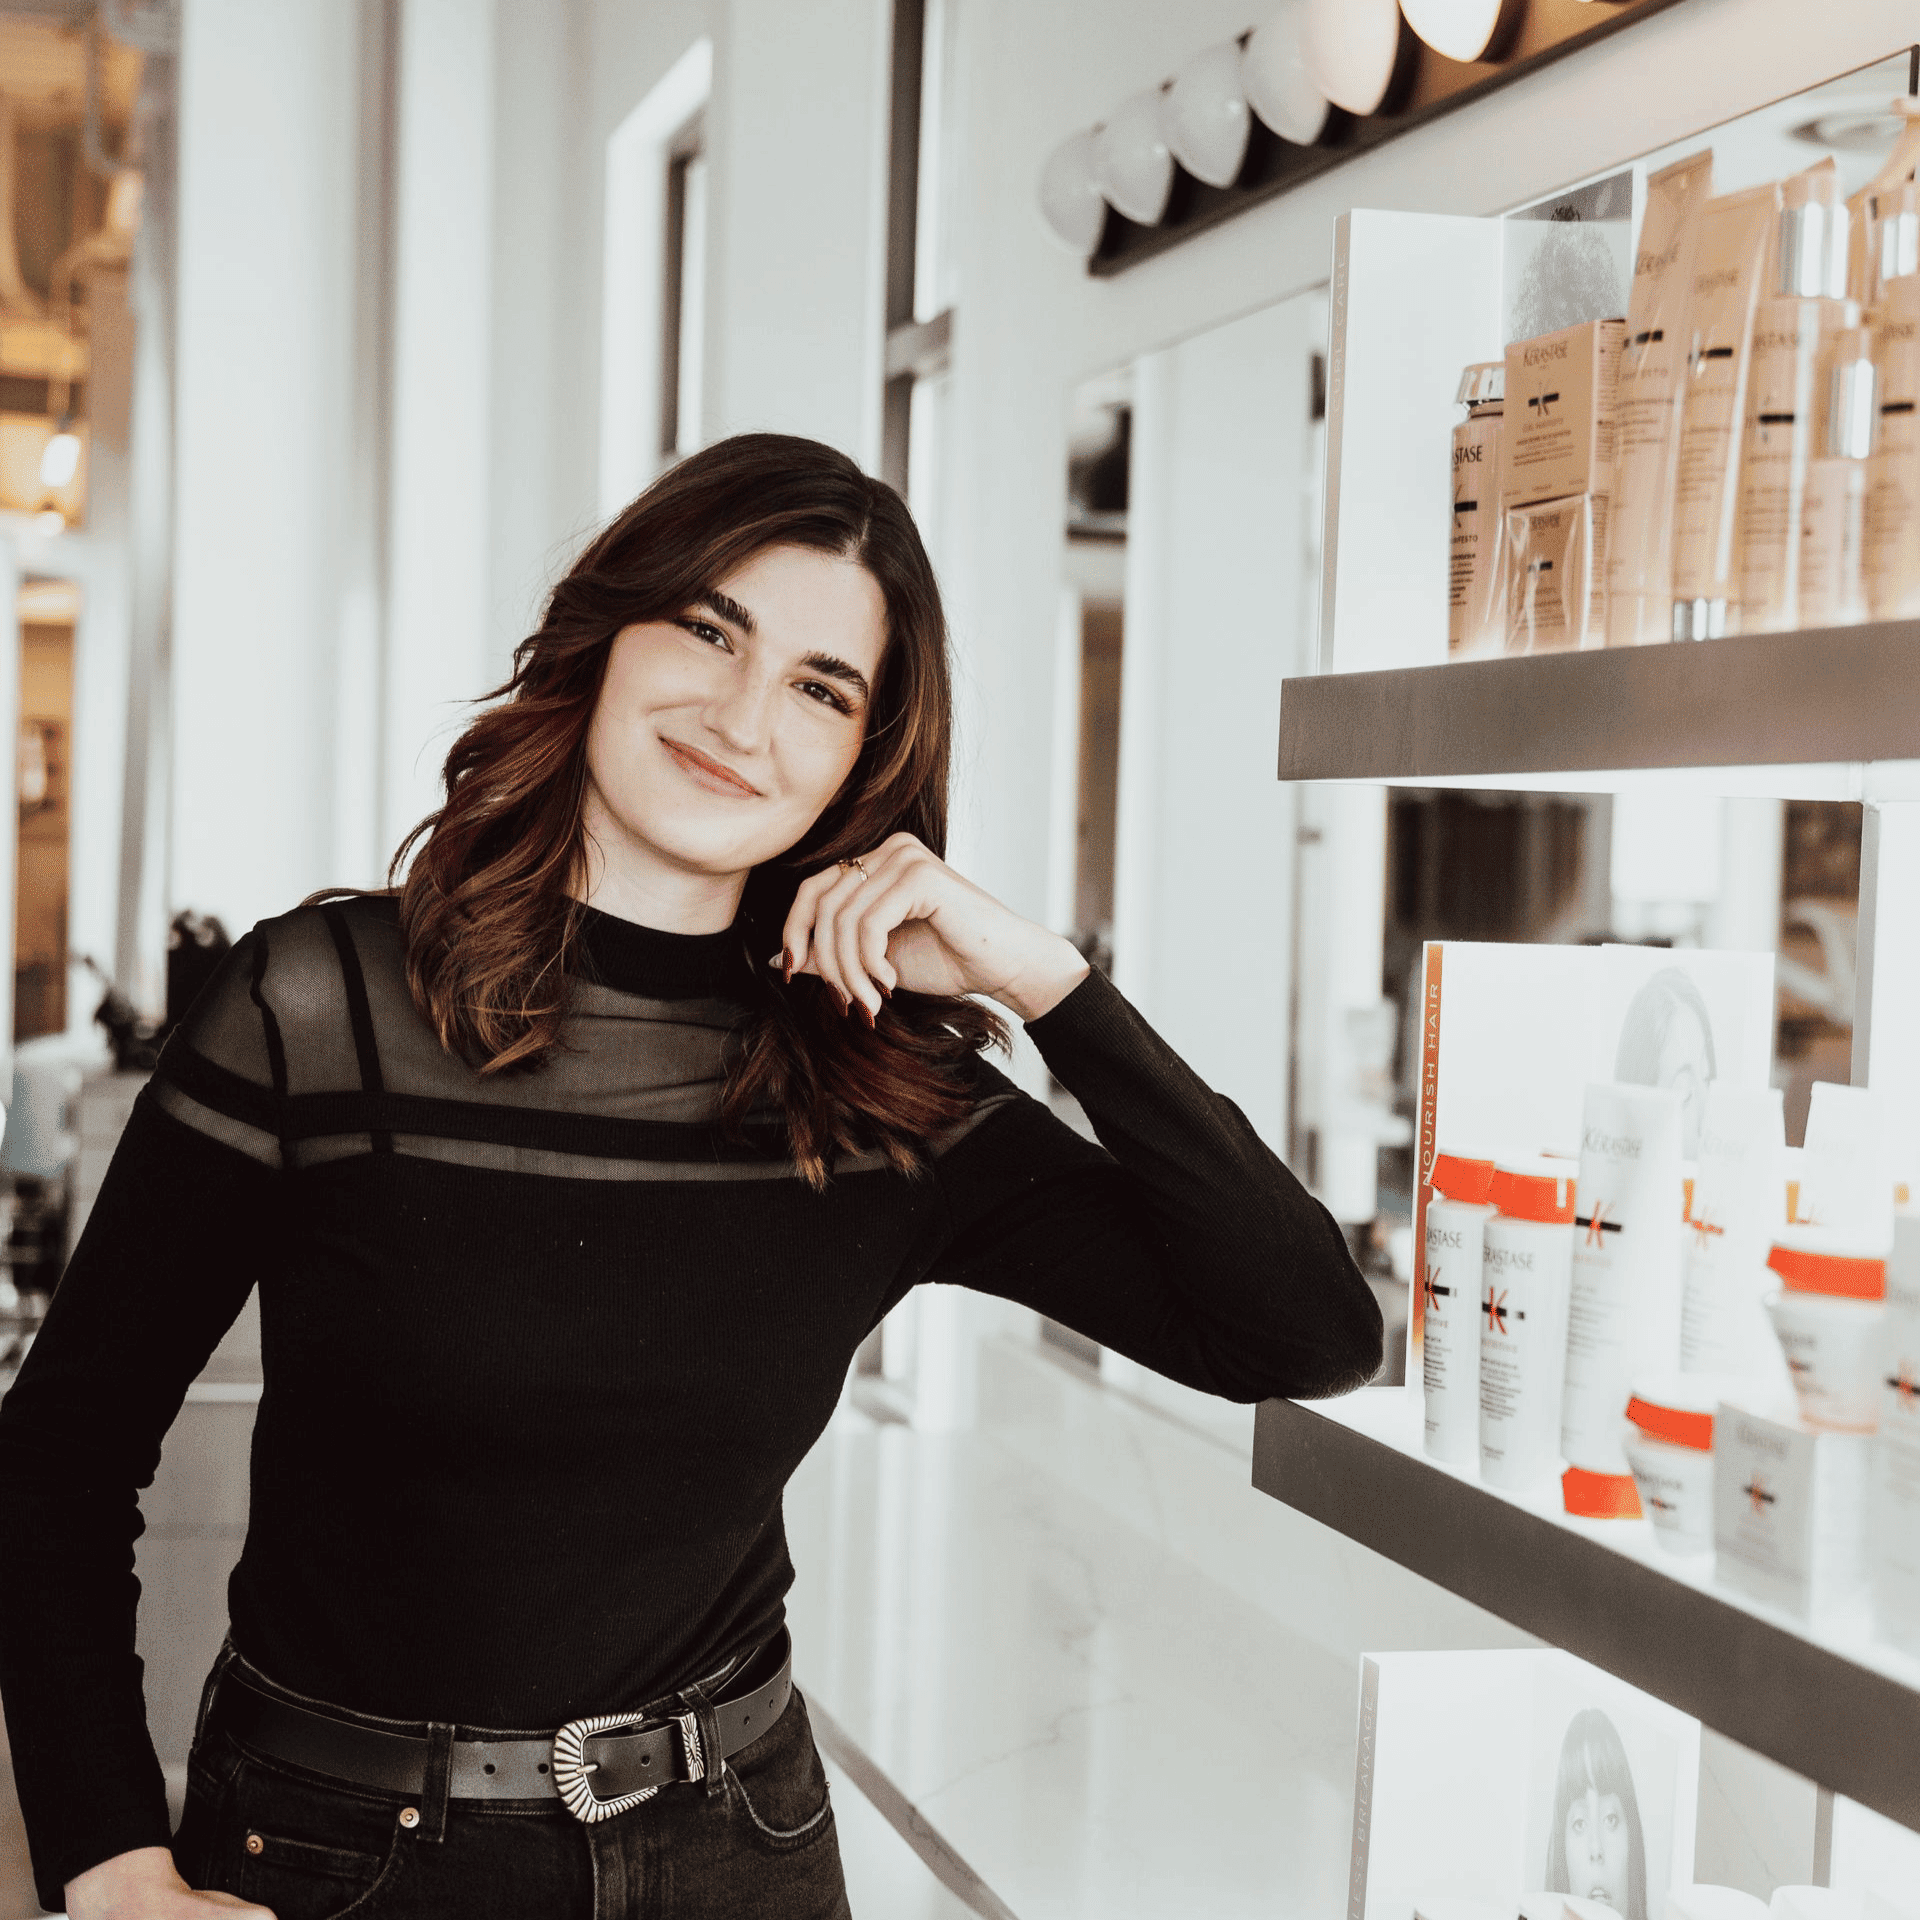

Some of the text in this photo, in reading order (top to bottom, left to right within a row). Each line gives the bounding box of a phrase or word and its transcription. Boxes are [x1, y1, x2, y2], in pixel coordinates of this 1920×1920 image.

[1335, 253, 1347, 327] CARE
[1422, 983, 1439, 1186] NOURISH HAIR
[1351, 1695, 1374, 1920] LESS BREAKAGE
